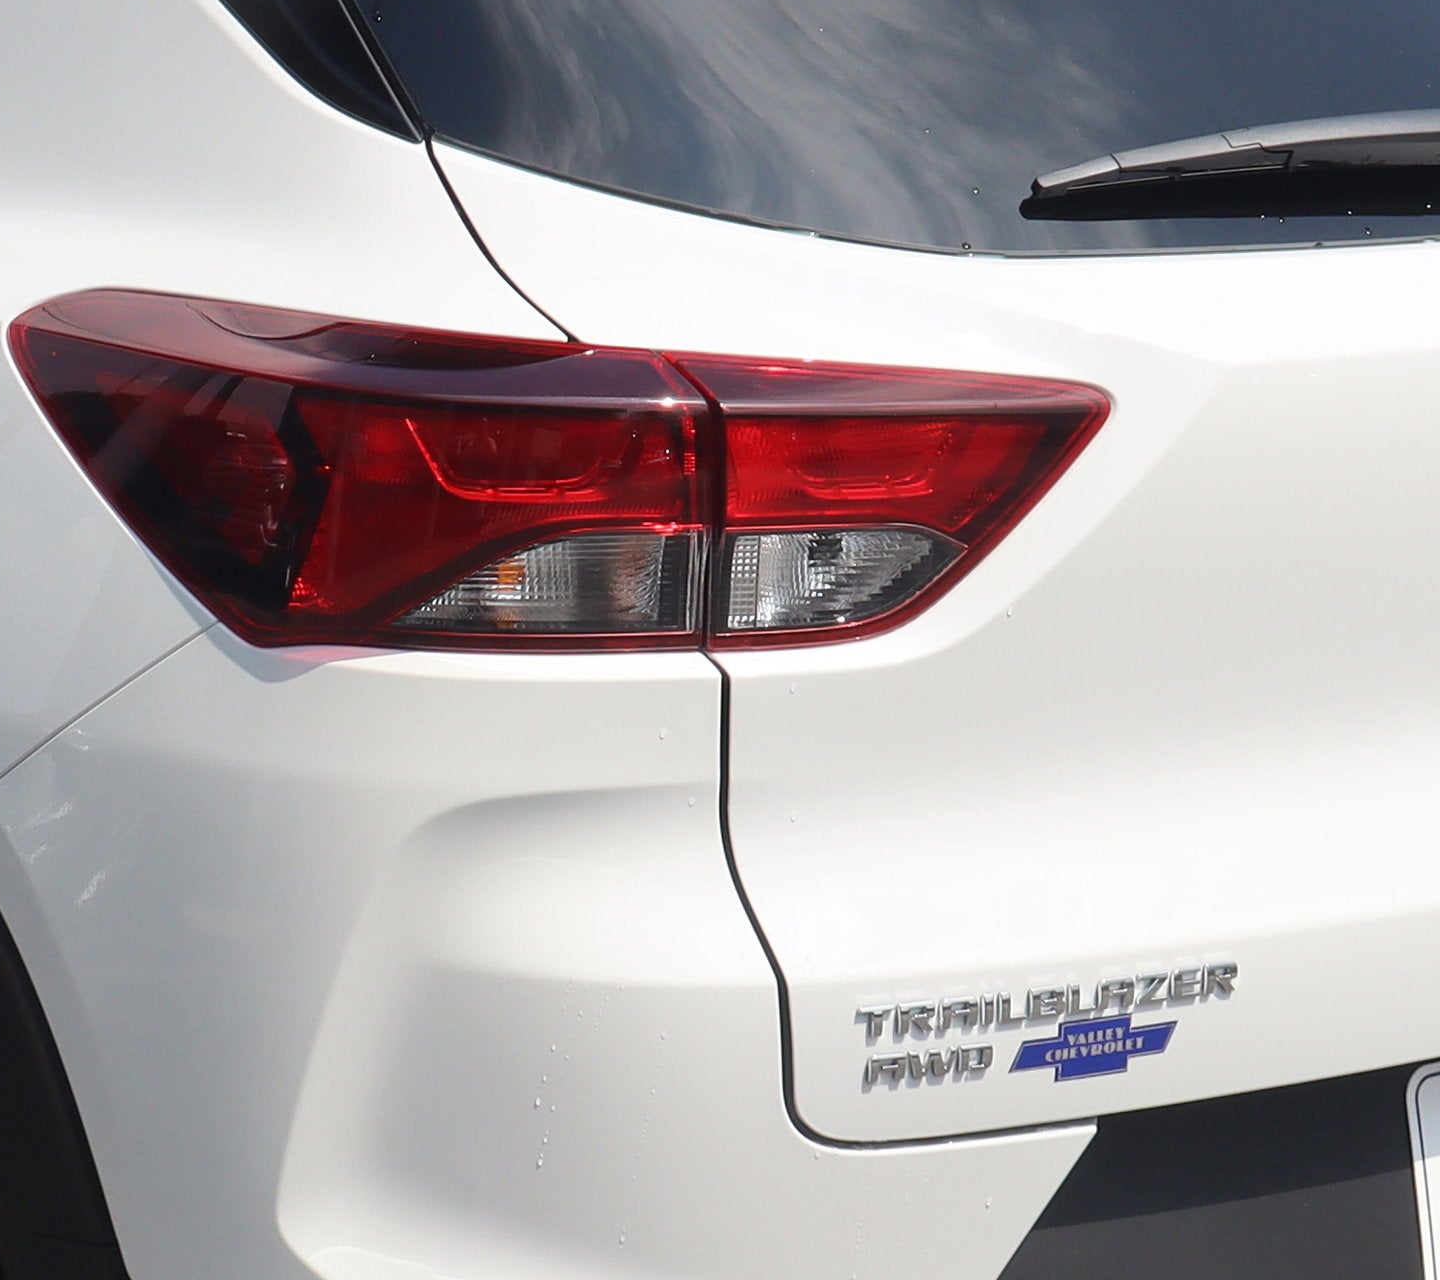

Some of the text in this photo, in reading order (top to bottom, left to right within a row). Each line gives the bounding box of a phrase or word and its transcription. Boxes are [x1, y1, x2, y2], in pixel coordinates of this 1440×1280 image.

[856, 960, 1239, 1038] TRAILBLAZER
[1044, 1035, 1146, 1064] CHEVROLET
[1067, 1026, 1126, 1047] VALLEY
[865, 1041, 994, 1084] AWD
